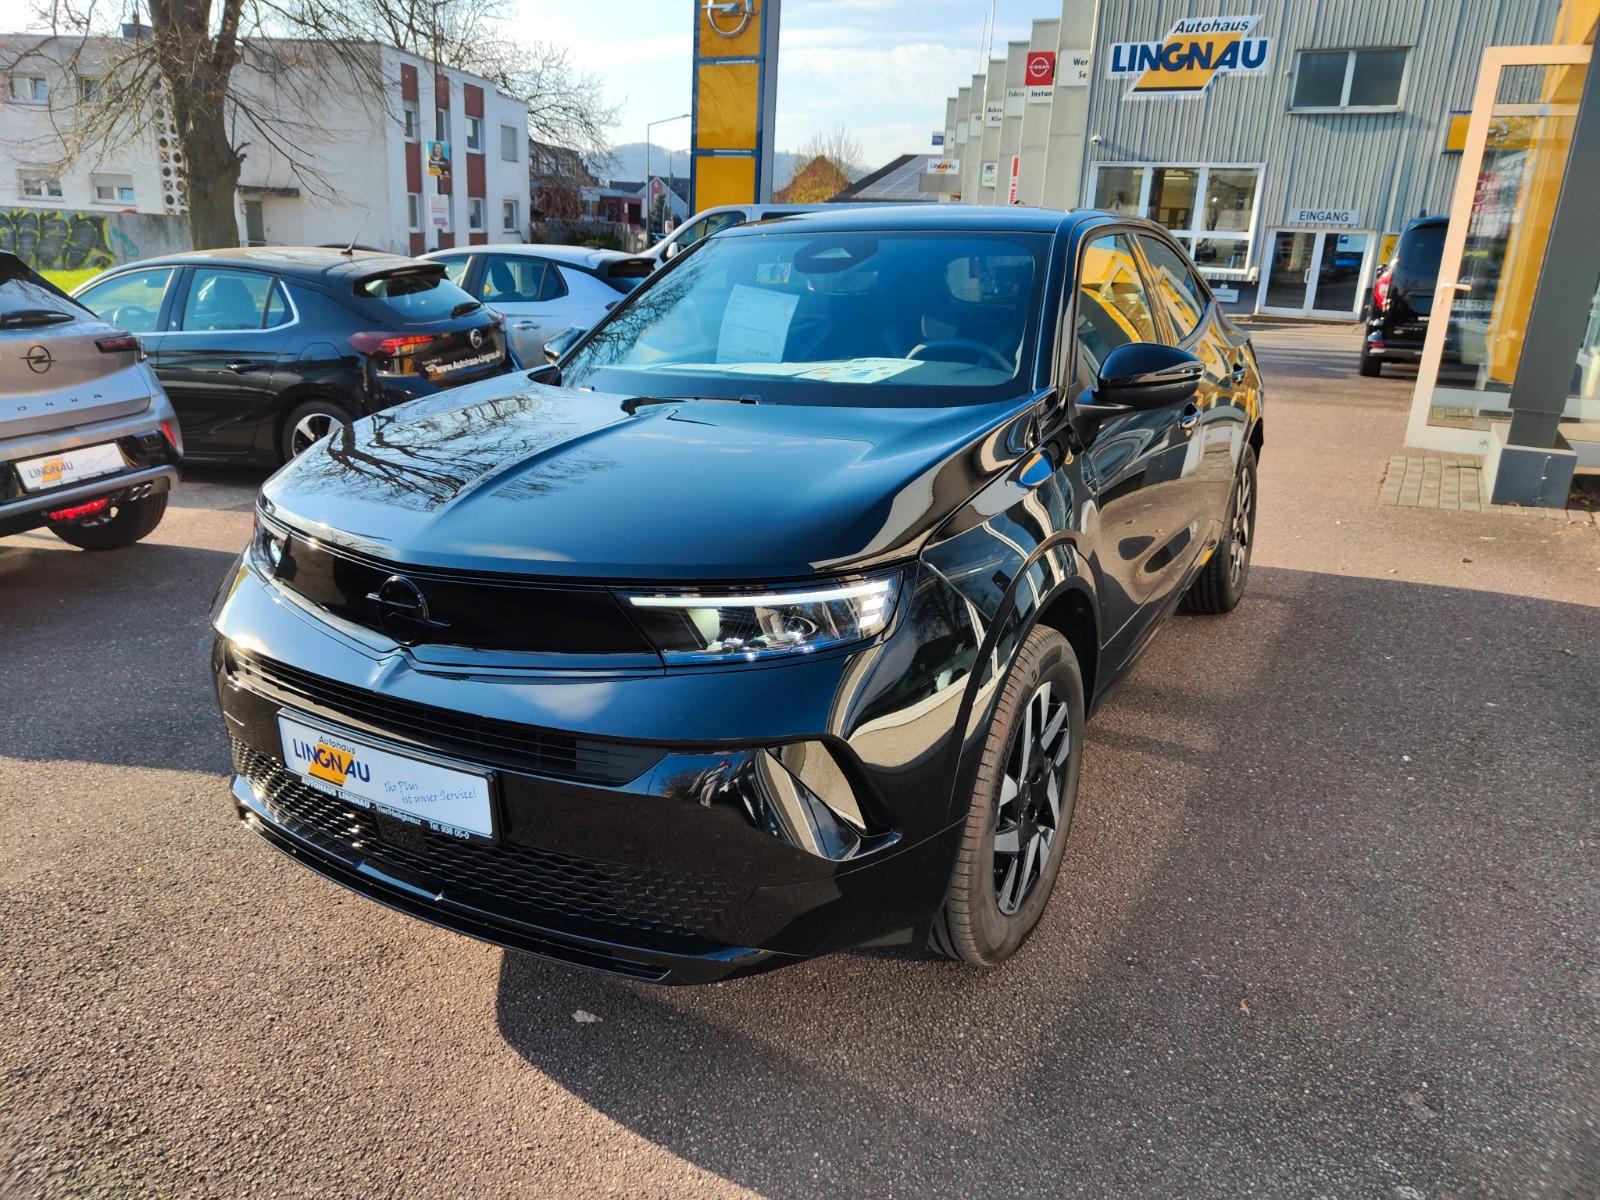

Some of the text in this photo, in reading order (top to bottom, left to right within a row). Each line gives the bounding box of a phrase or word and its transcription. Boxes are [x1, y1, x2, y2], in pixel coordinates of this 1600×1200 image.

[1174, 19, 1250, 34] Autohaus
[1111, 39, 1268, 73] LINGNAU
[1299, 210, 1350, 222] EINGANG
[28, 460, 74, 479] LINGNAU
[318, 735, 356, 755] Autohaus
[292, 738, 371, 783] LINGNAU
[301, 776, 337, 797] AUTOHAUS
[338, 790, 371, 809] LINGNAU
[439, 786, 477, 801] Service!
